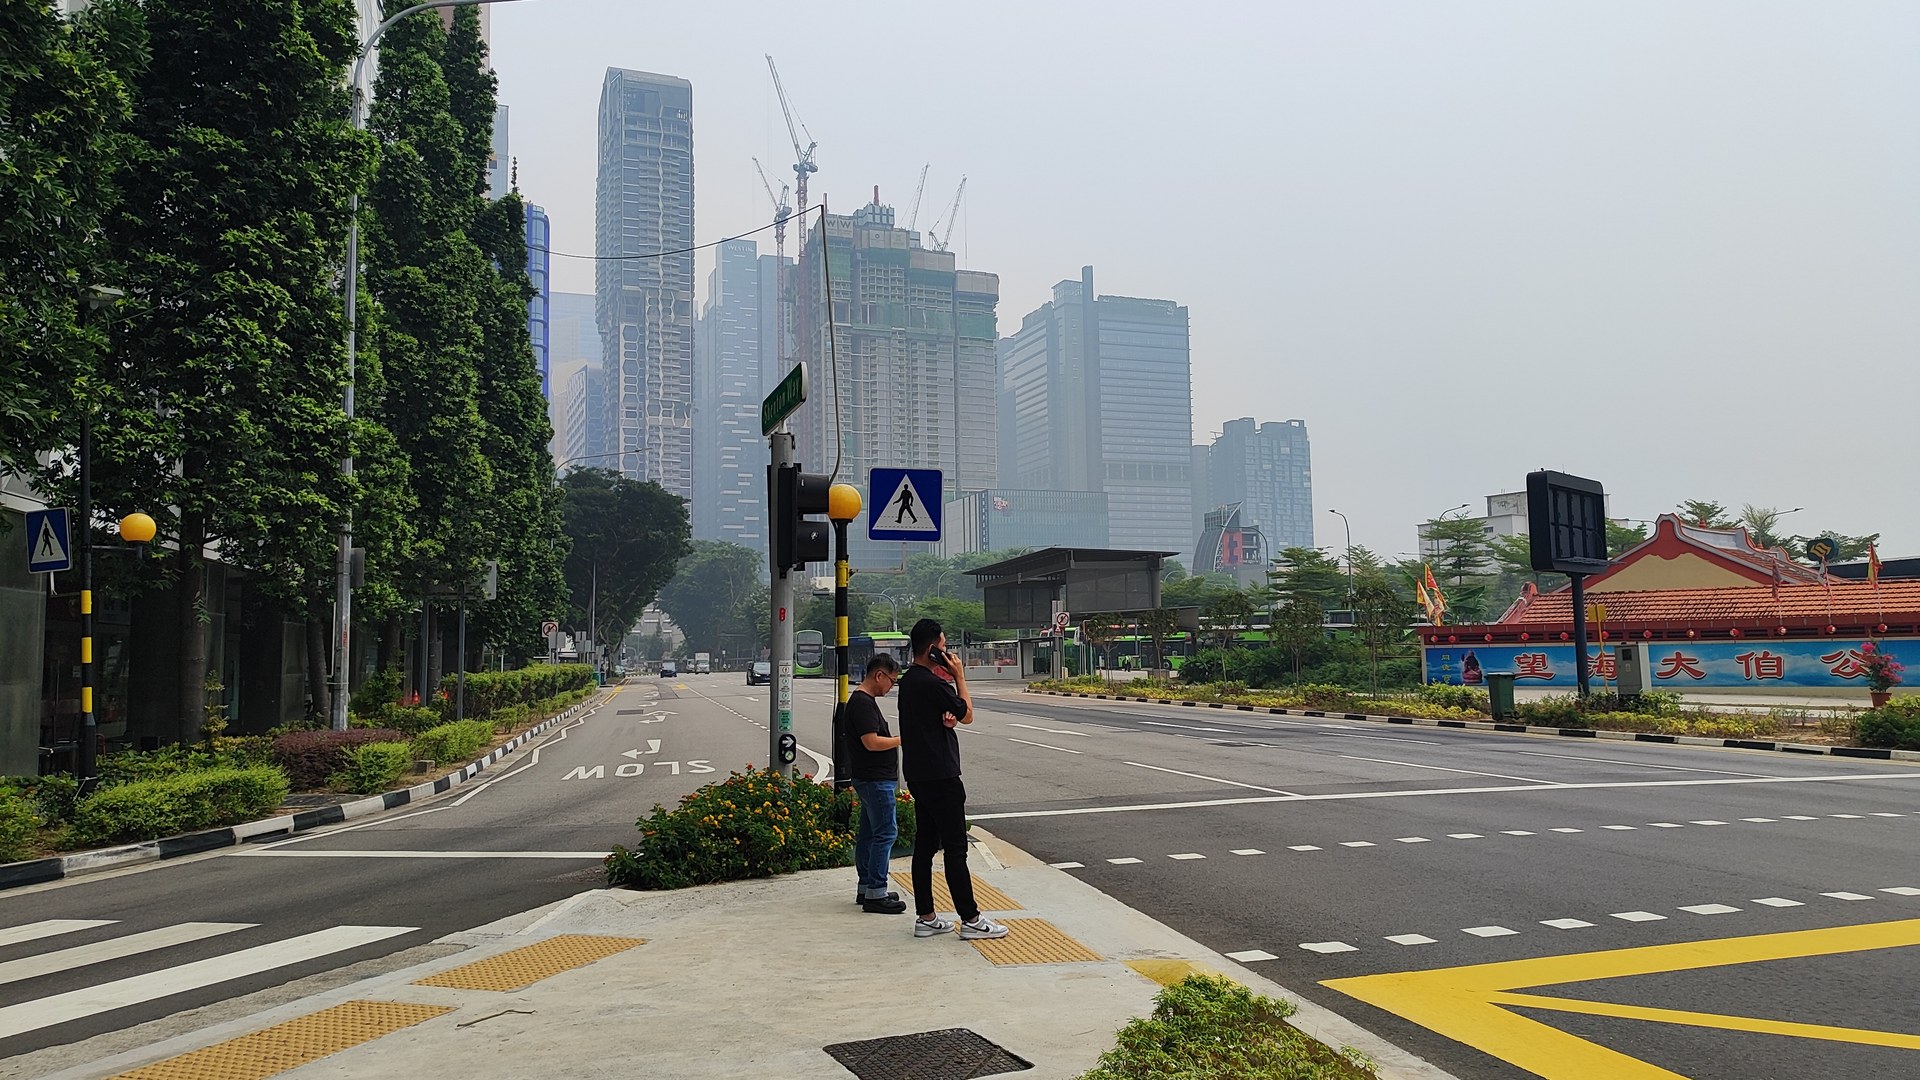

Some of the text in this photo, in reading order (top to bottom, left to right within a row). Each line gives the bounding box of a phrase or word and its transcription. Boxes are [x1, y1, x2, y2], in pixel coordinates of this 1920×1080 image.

[764, 377, 800, 425] Shenton Way
[561, 760, 716, 781] SLOW
